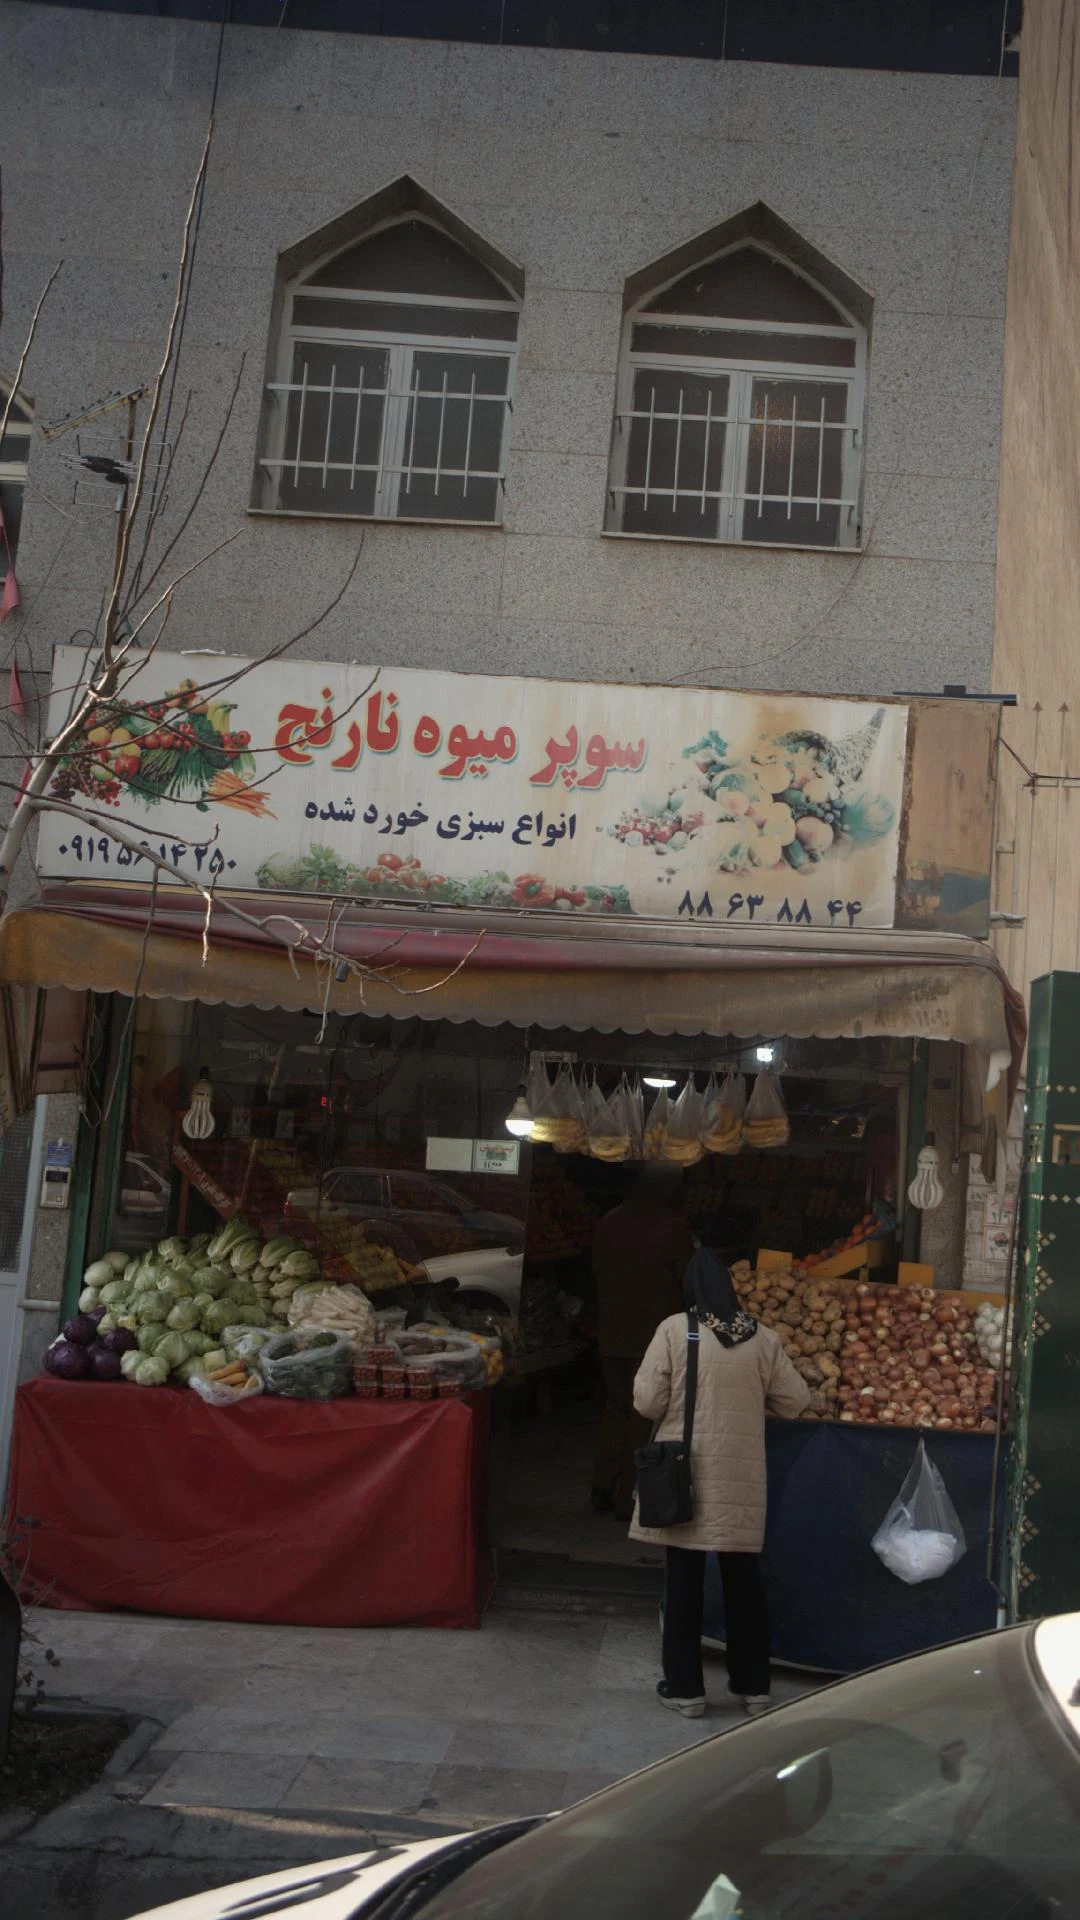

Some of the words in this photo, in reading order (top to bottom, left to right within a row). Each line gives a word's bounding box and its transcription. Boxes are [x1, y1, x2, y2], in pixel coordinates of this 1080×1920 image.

[274, 687, 400, 772] نارنج
[412, 715, 518, 779] میوه
[529, 724, 646, 790] سوپر
[305, 796, 355, 822] شده
[363, 801, 429, 835] خورد
[436, 811, 505, 841] سبزی
[512, 811, 577, 847] انواع
